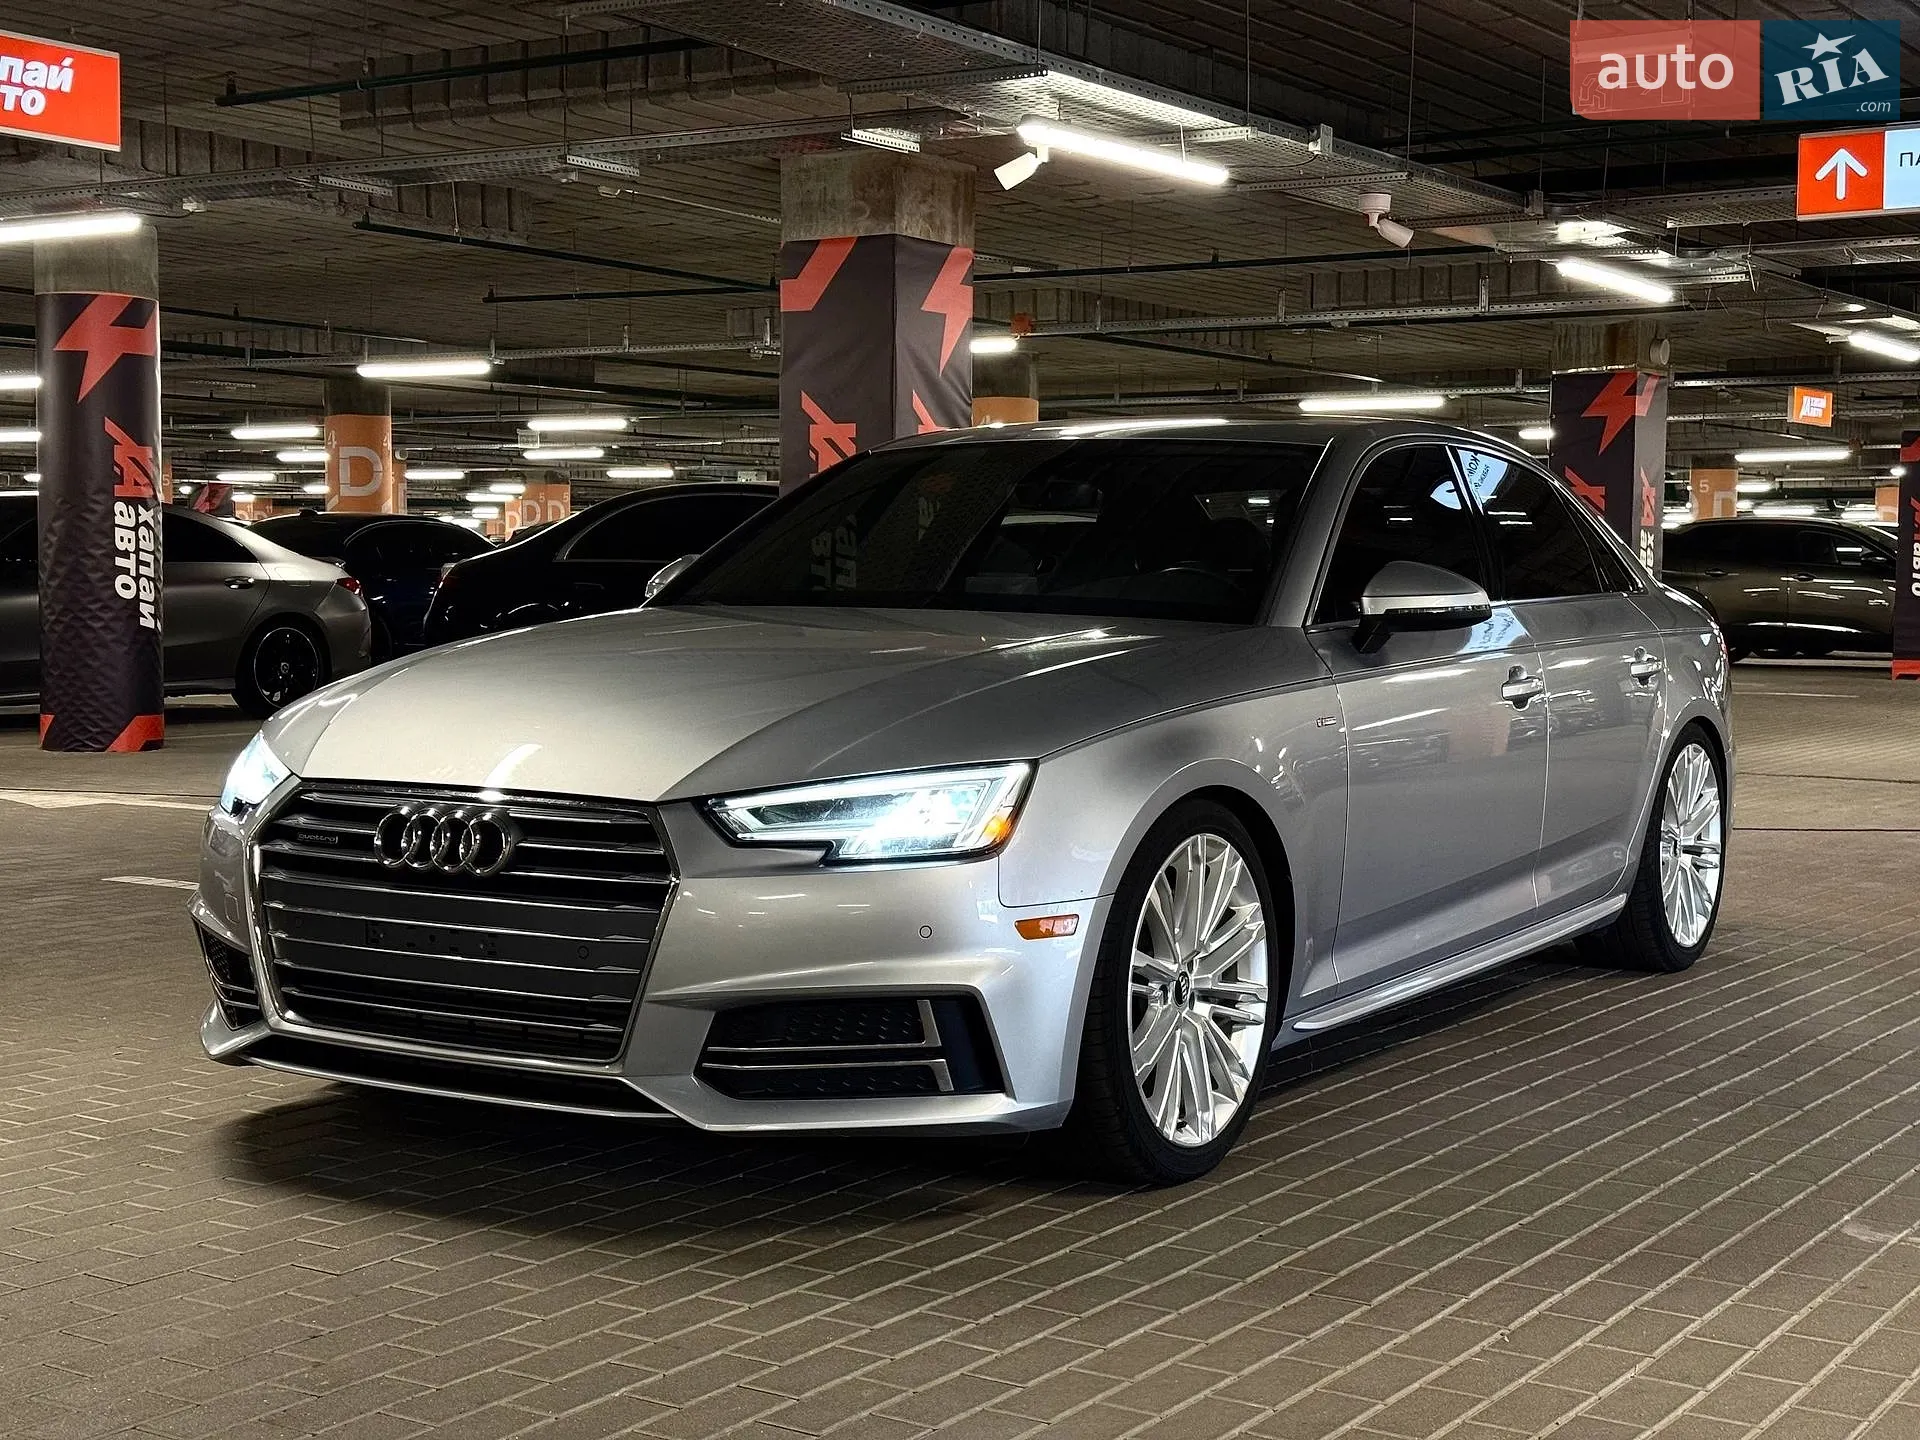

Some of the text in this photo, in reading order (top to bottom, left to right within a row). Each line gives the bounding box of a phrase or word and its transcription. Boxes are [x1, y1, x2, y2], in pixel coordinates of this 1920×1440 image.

[339, 446, 384, 497] D
[114, 501, 137, 600] авто
[138, 504, 162, 633] хапай
